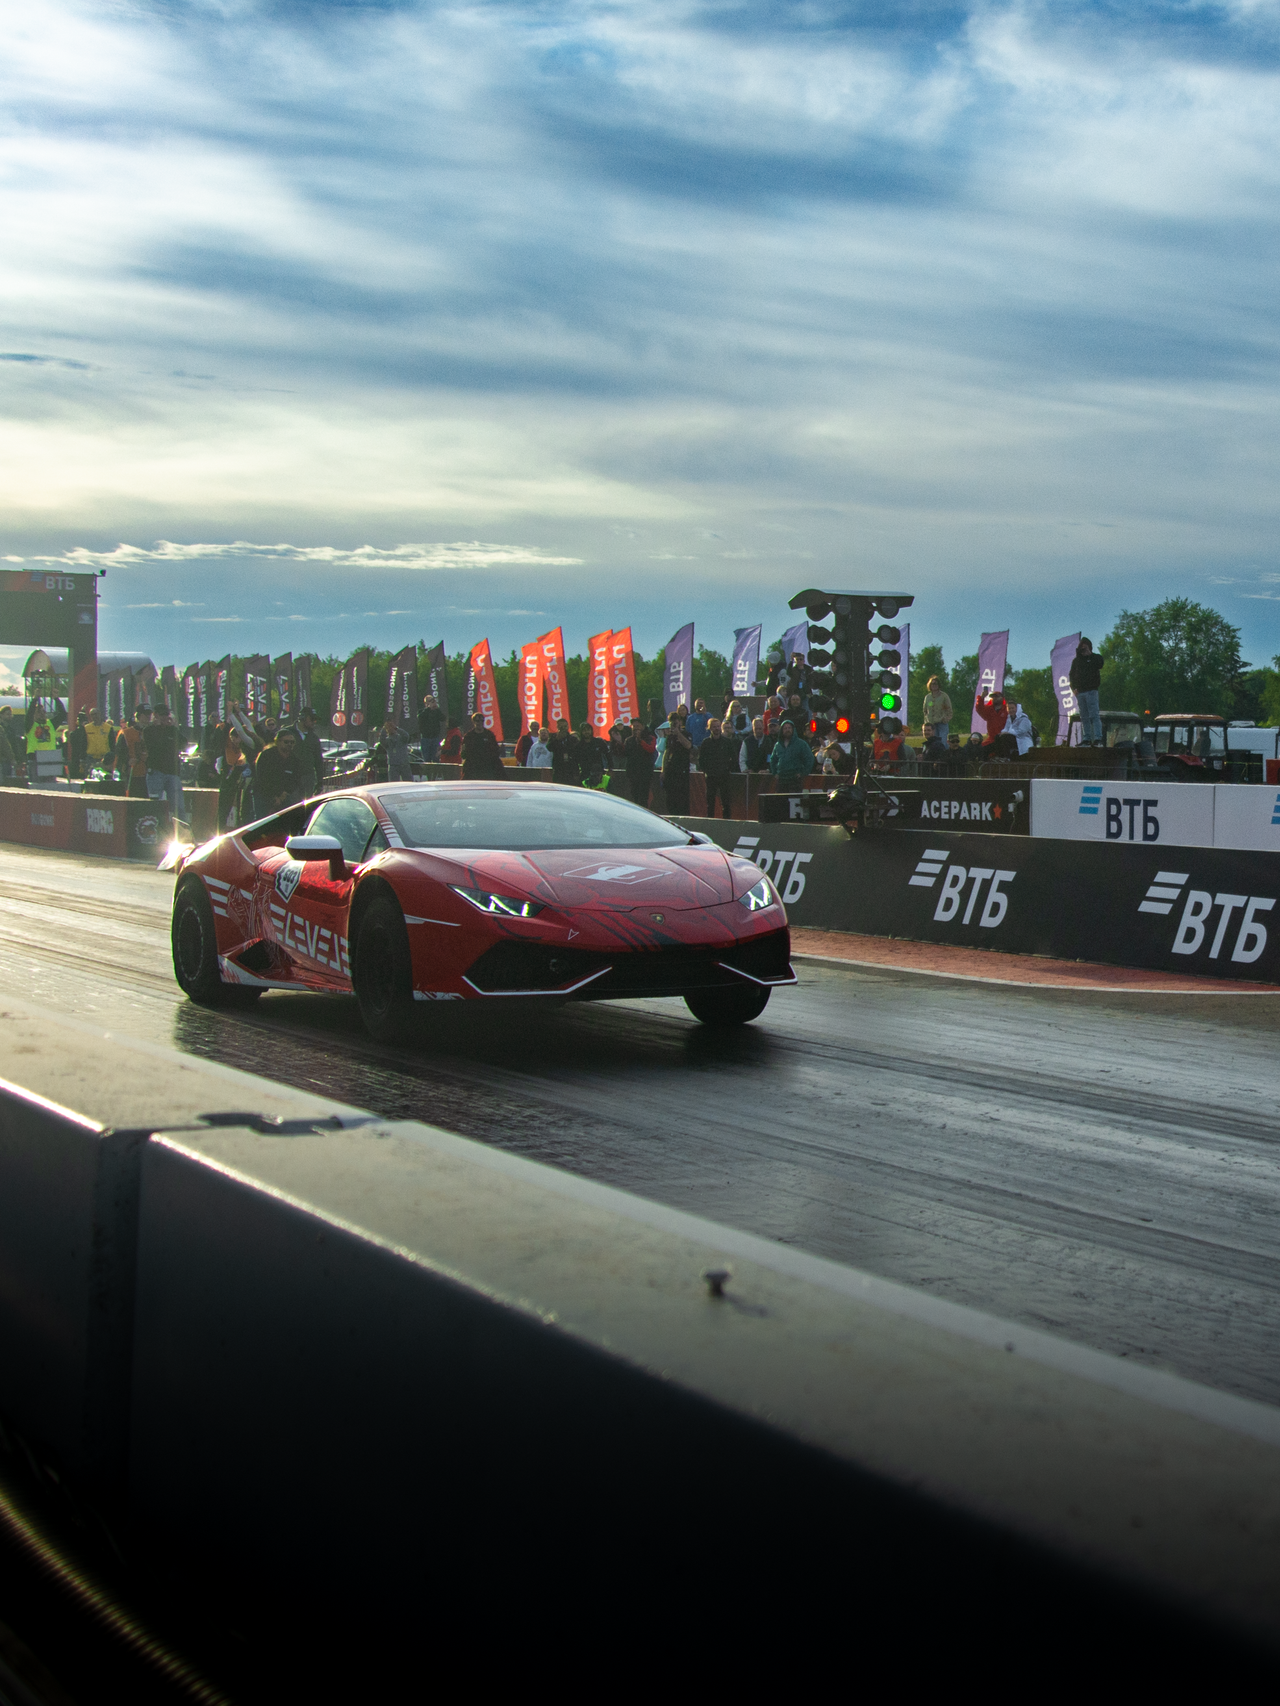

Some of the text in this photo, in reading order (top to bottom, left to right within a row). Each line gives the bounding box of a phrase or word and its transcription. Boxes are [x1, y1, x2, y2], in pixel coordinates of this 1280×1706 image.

[45, 576, 75, 590] ВТБ
[1105, 797, 1160, 842] ВТБ
[933, 865, 1017, 928] ВТБ
[1171, 889, 1277, 964] ВТБ
